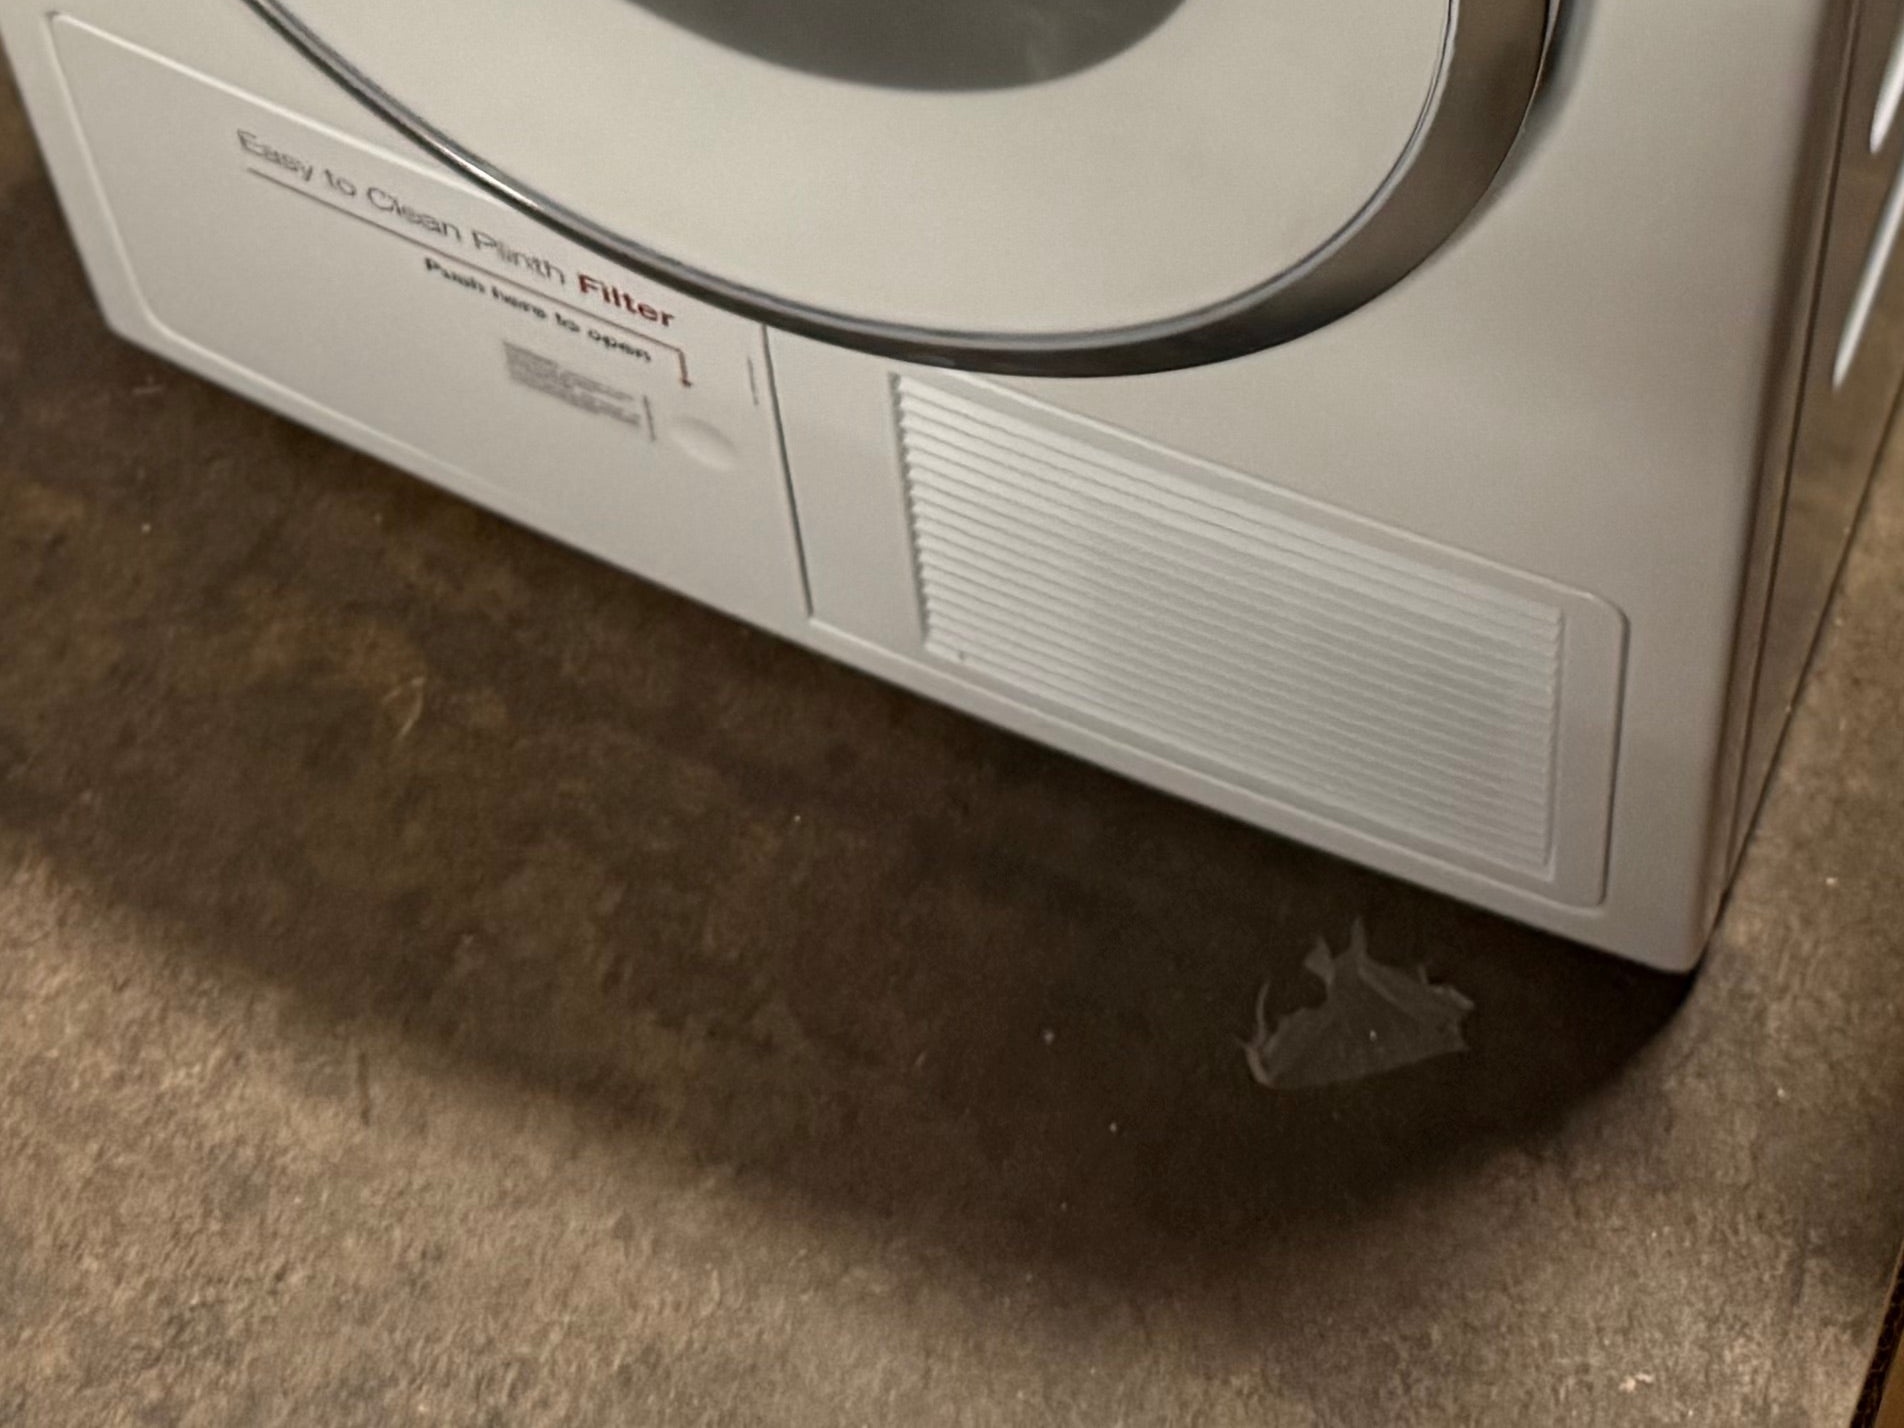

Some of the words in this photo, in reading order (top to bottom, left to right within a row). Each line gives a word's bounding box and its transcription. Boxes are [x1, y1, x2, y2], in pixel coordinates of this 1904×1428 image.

[236, 129, 314, 182] Easy
[323, 167, 357, 197] to
[366, 186, 462, 243] Clean
[472, 225, 566, 286] Plinth
[577, 273, 675, 329] Filter
[424, 256, 486, 296] Push
[493, 284, 548, 321] here
[554, 311, 581, 332] to
[587, 327, 652, 364] open
